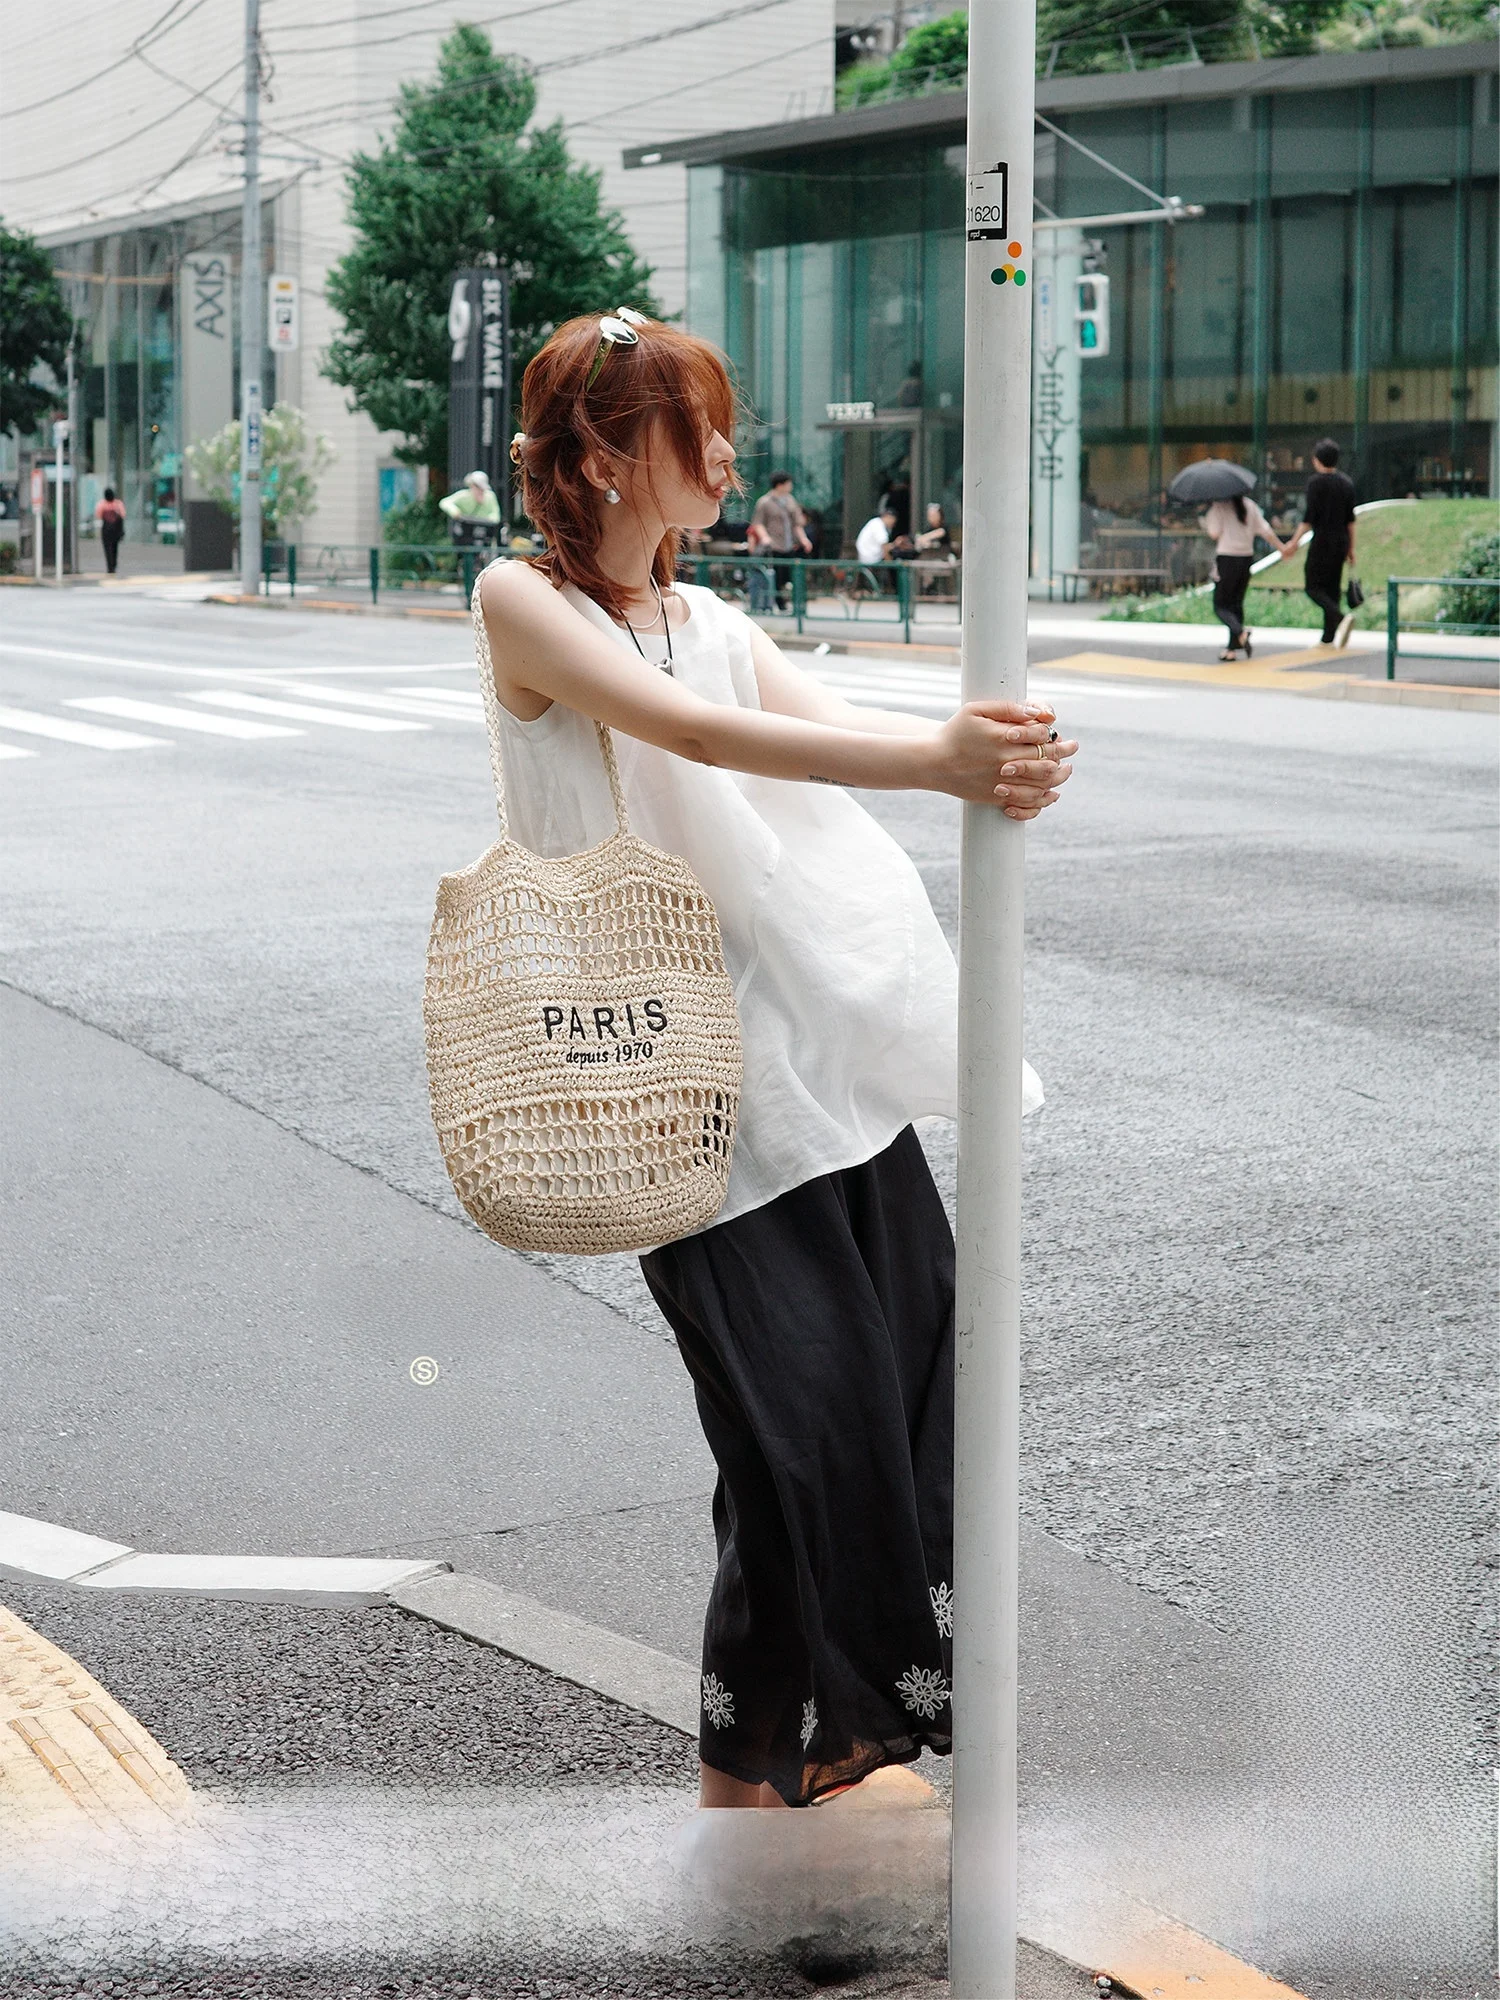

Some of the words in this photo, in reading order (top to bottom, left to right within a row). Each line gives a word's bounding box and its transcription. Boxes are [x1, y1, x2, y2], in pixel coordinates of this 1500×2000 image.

[194, 260, 225, 339] AXIS
[482, 279, 502, 316] SIX
[483, 321, 503, 389] WAKE
[1038, 345, 1074, 479] VERVE
[542, 999, 668, 1041] PARIS
[566, 1046, 609, 1070] depuis
[615, 1041, 654, 1063] 1970
